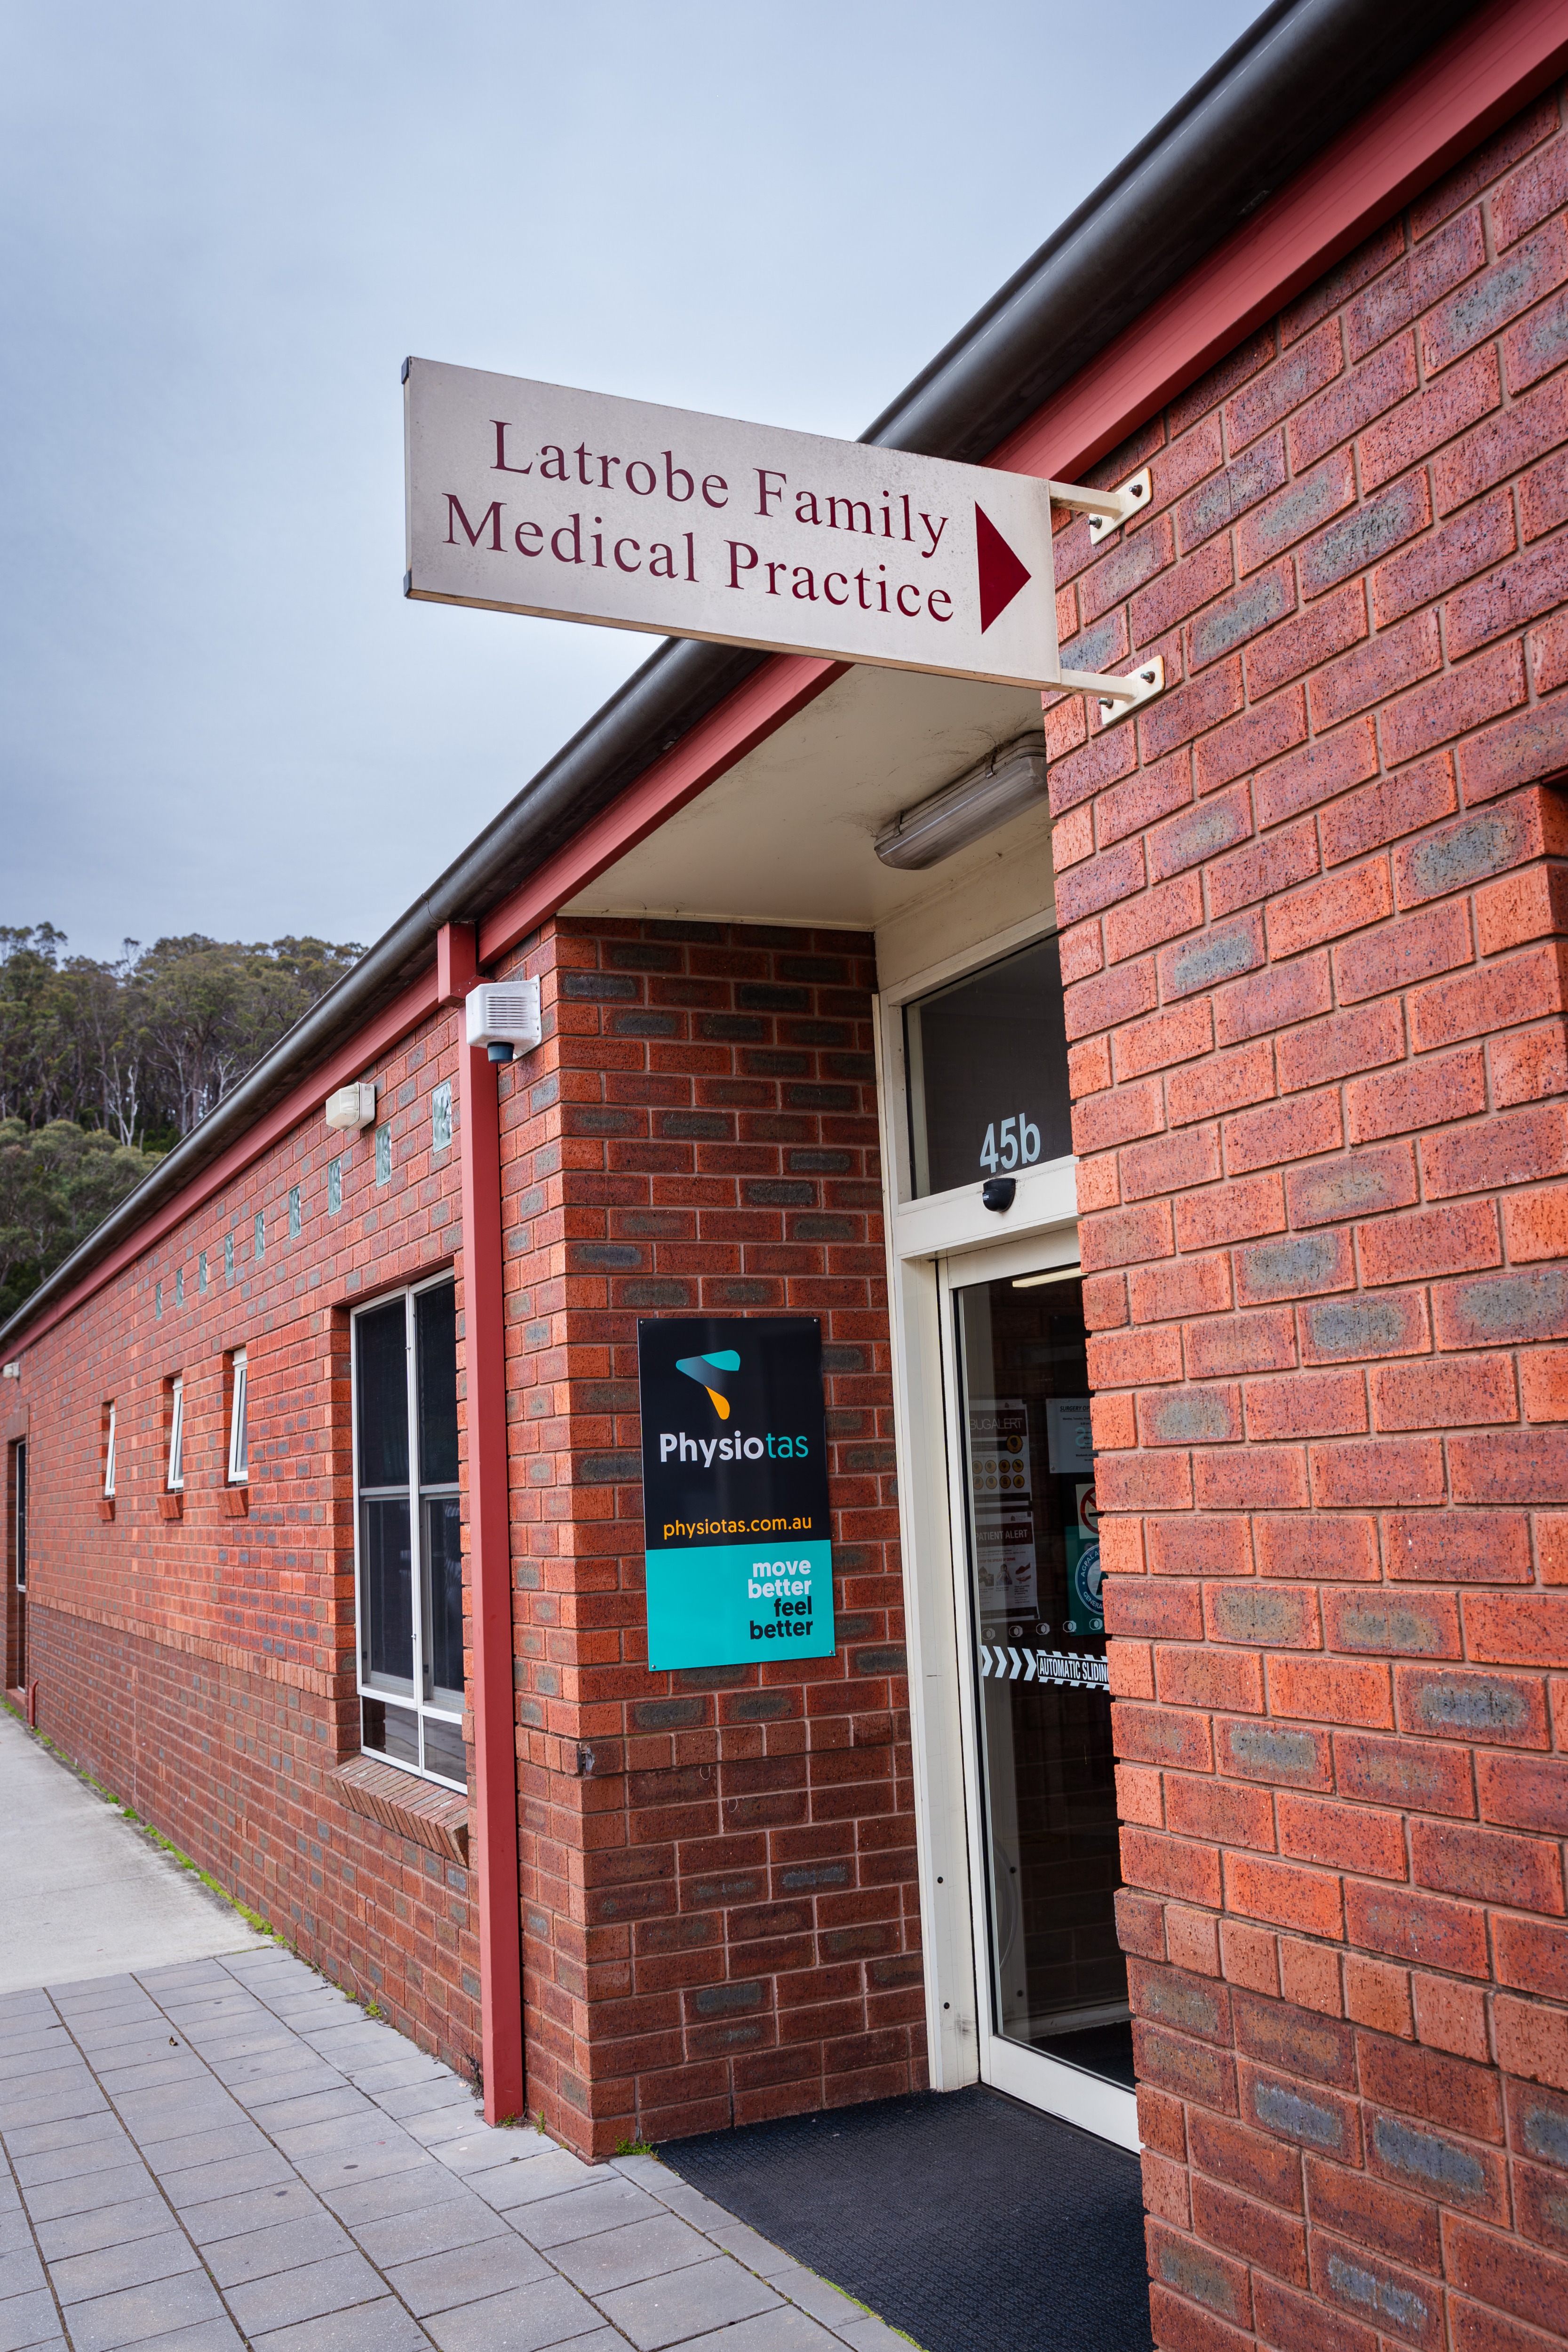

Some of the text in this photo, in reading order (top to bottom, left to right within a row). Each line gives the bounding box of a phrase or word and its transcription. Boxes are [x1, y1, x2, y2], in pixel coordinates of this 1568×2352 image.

[489, 419, 949, 558] Latrobe Family
[441, 492, 954, 622] Medical Practice
[979, 1112, 1041, 1174] 45b
[660, 1430, 809, 1468] Physiotas
[663, 1517, 812, 1540] physiotas.com.au
[1005, 1529, 1027, 1539] ALERT
[753, 1560, 811, 1578] move
[1081, 1554, 1094, 1577] AGPAL
[748, 1579, 812, 1598] better
[773, 1596, 812, 1617] feel
[749, 1620, 813, 1640] better
[1040, 1657, 1081, 1679] AUTOMATIC
